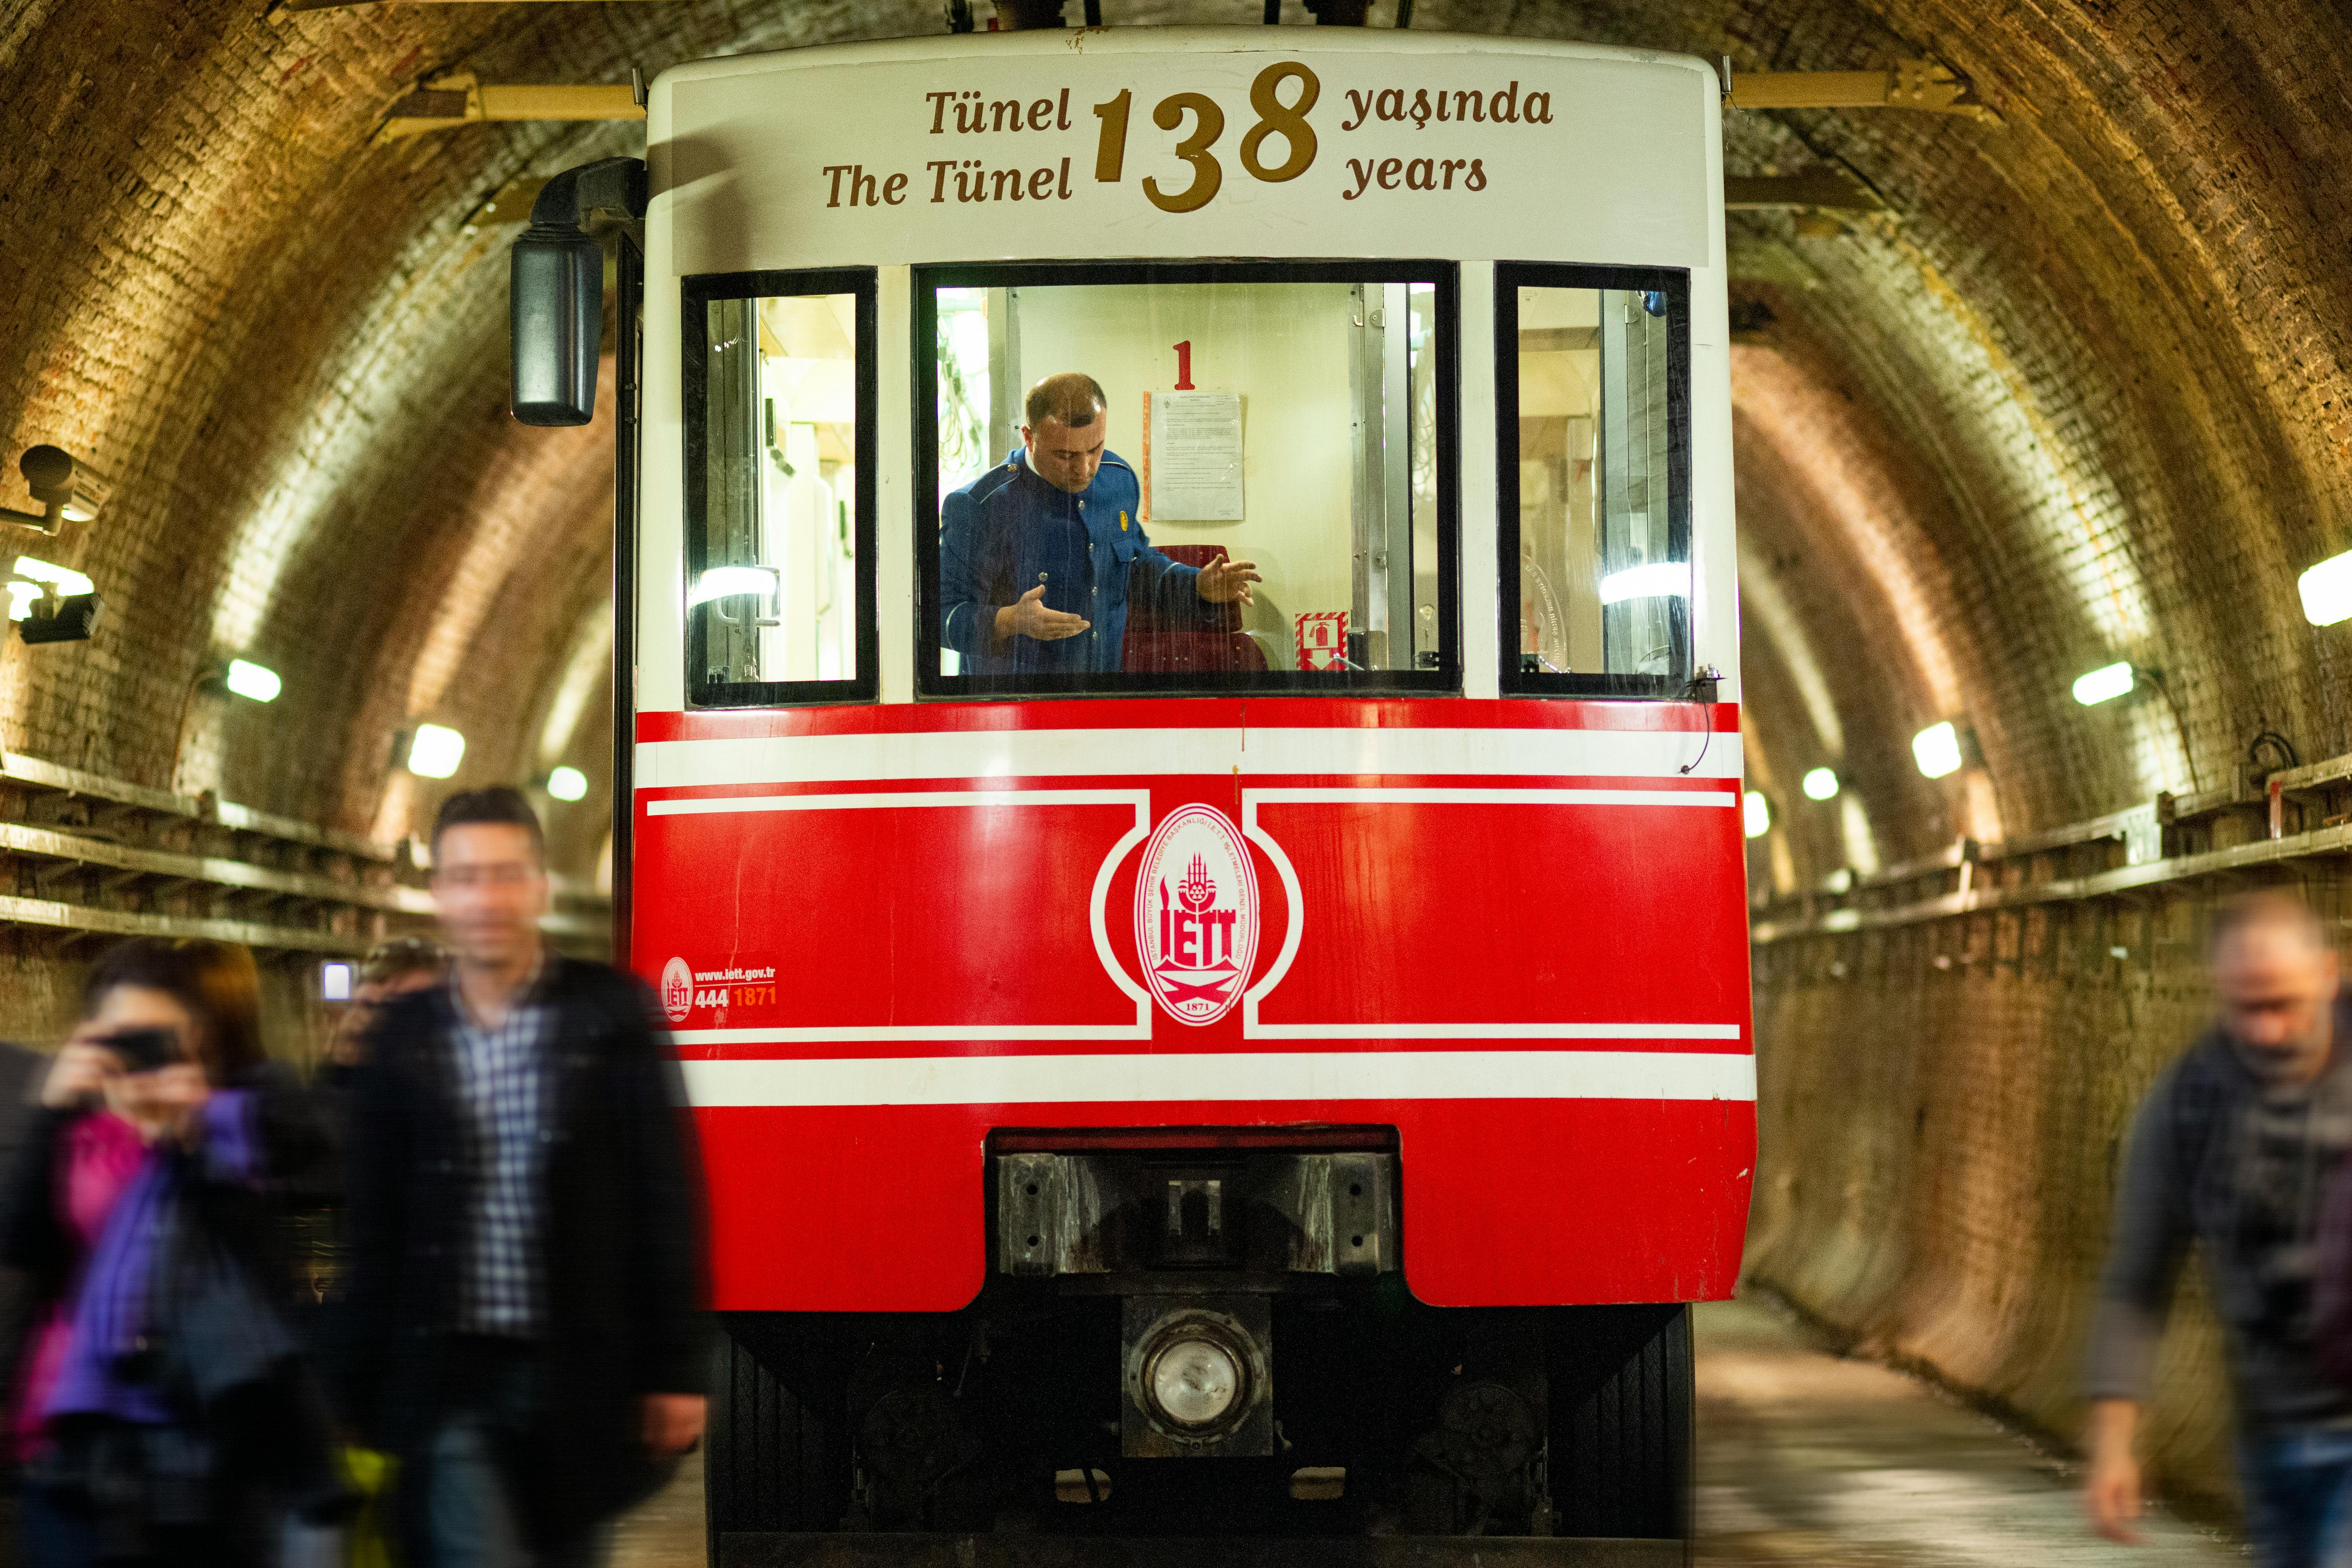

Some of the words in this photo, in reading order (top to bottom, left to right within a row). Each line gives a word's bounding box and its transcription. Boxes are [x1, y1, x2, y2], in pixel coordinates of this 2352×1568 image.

[925, 88, 1072, 134] Tünel
[1093, 61, 1321, 213] 138
[1342, 80, 1553, 131] yaşında
[822, 164, 908, 208] The
[926, 157, 1072, 203] Tünel
[1342, 158, 1487, 200] years
[1172, 339, 1196, 391] 1
[695, 966, 776, 981] www.iett.gov.tr
[695, 989, 729, 1008] 444
[734, 986, 776, 1006] 1871
